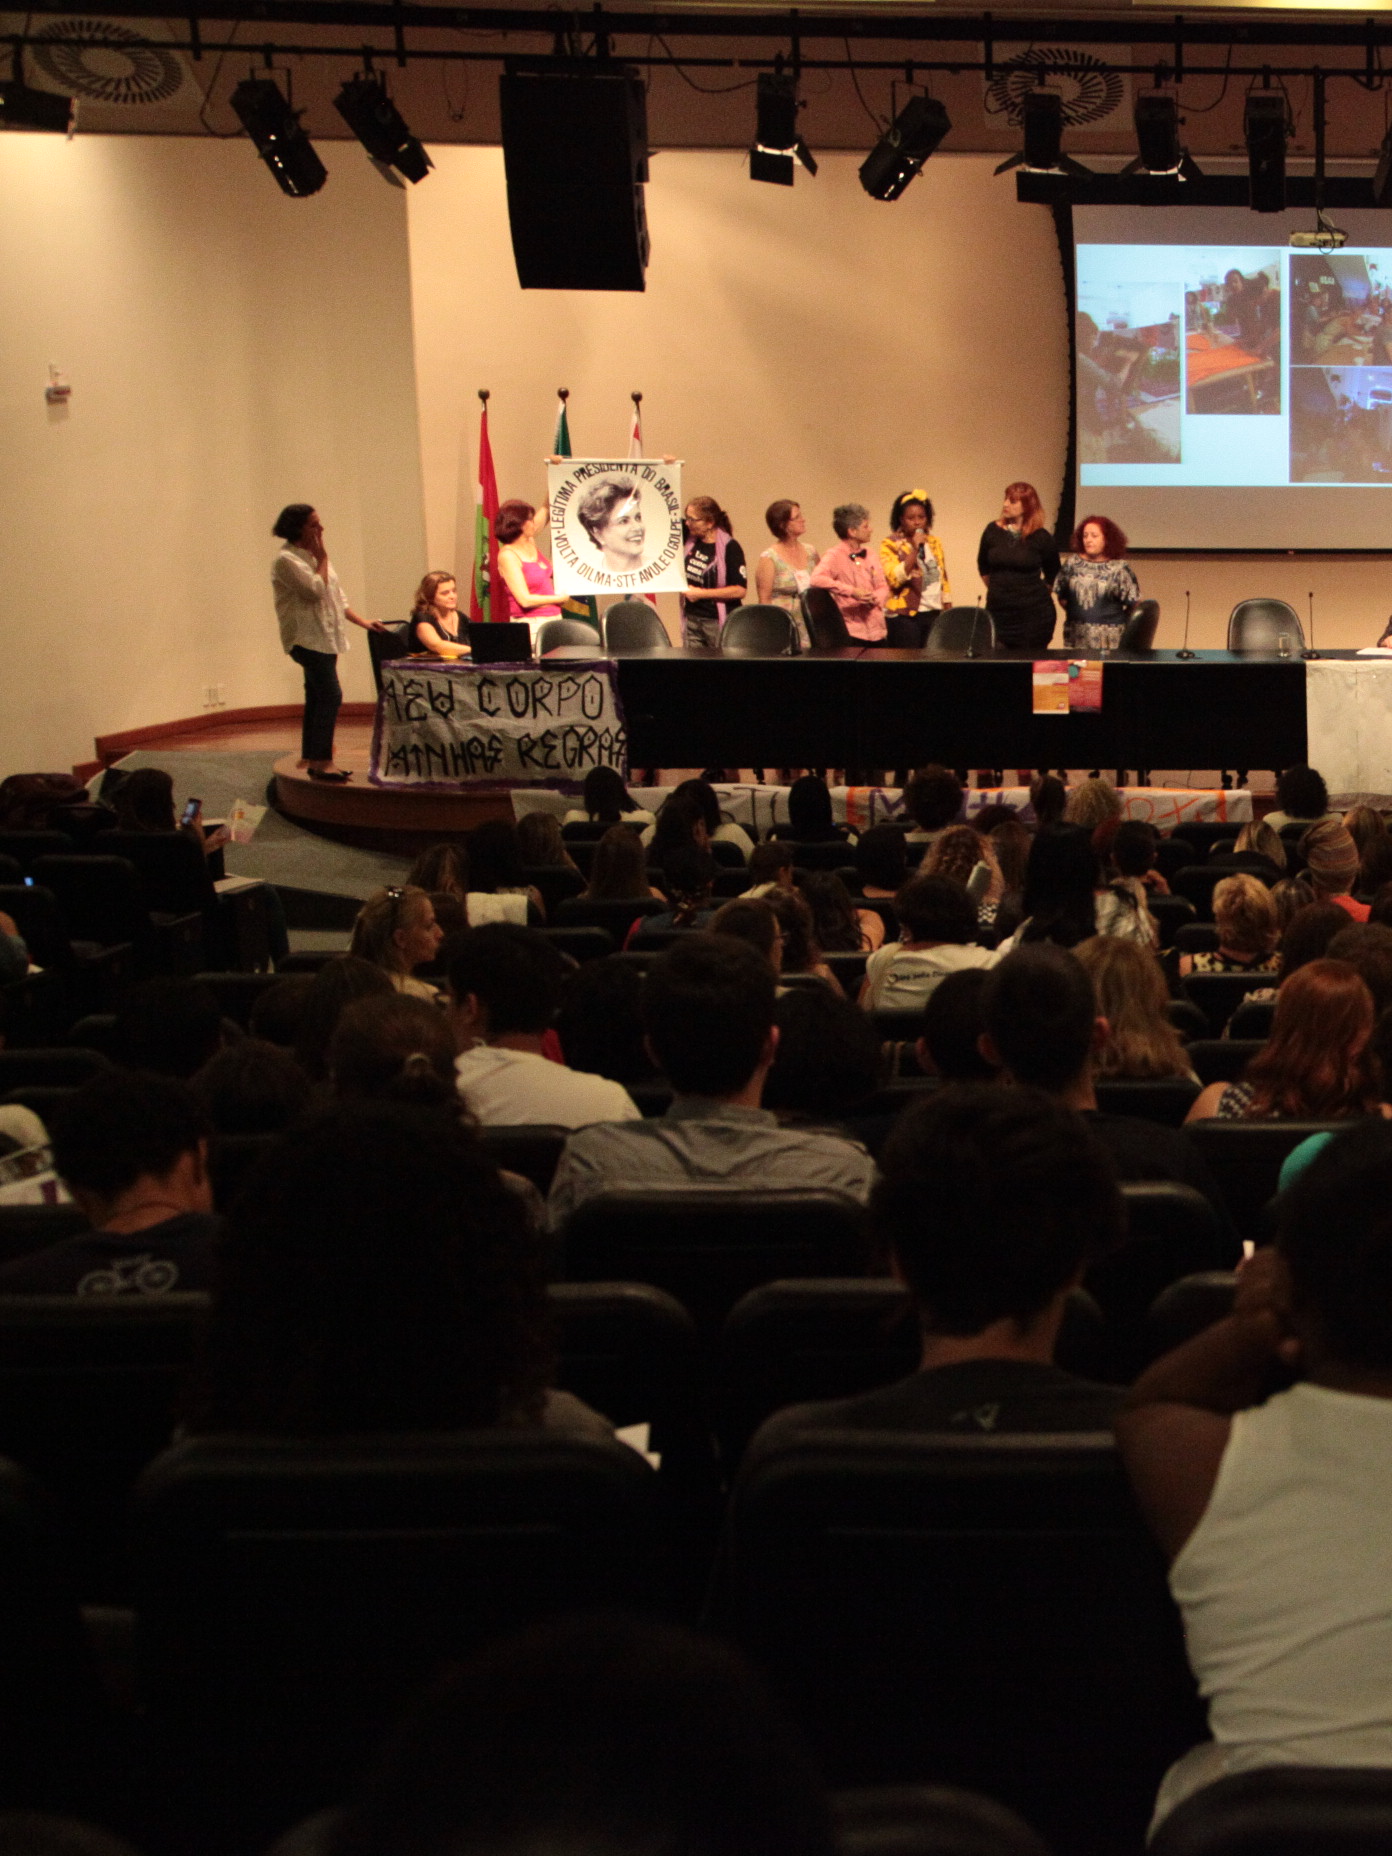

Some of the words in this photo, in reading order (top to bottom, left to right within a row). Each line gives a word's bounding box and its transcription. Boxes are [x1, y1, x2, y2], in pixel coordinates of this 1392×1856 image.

[641, 465, 657, 482] DO
[654, 477, 680, 514] BRASIL
[664, 548, 676, 560] O
[668, 518, 682, 551] GOLPE
[554, 533, 579, 568] VOLTA
[576, 562, 611, 587] DILMA
[638, 555, 671, 584] ANULE
[616, 573, 637, 588] STF
[477, 674, 604, 720] CORPO
[516, 725, 628, 770] REGRAS
